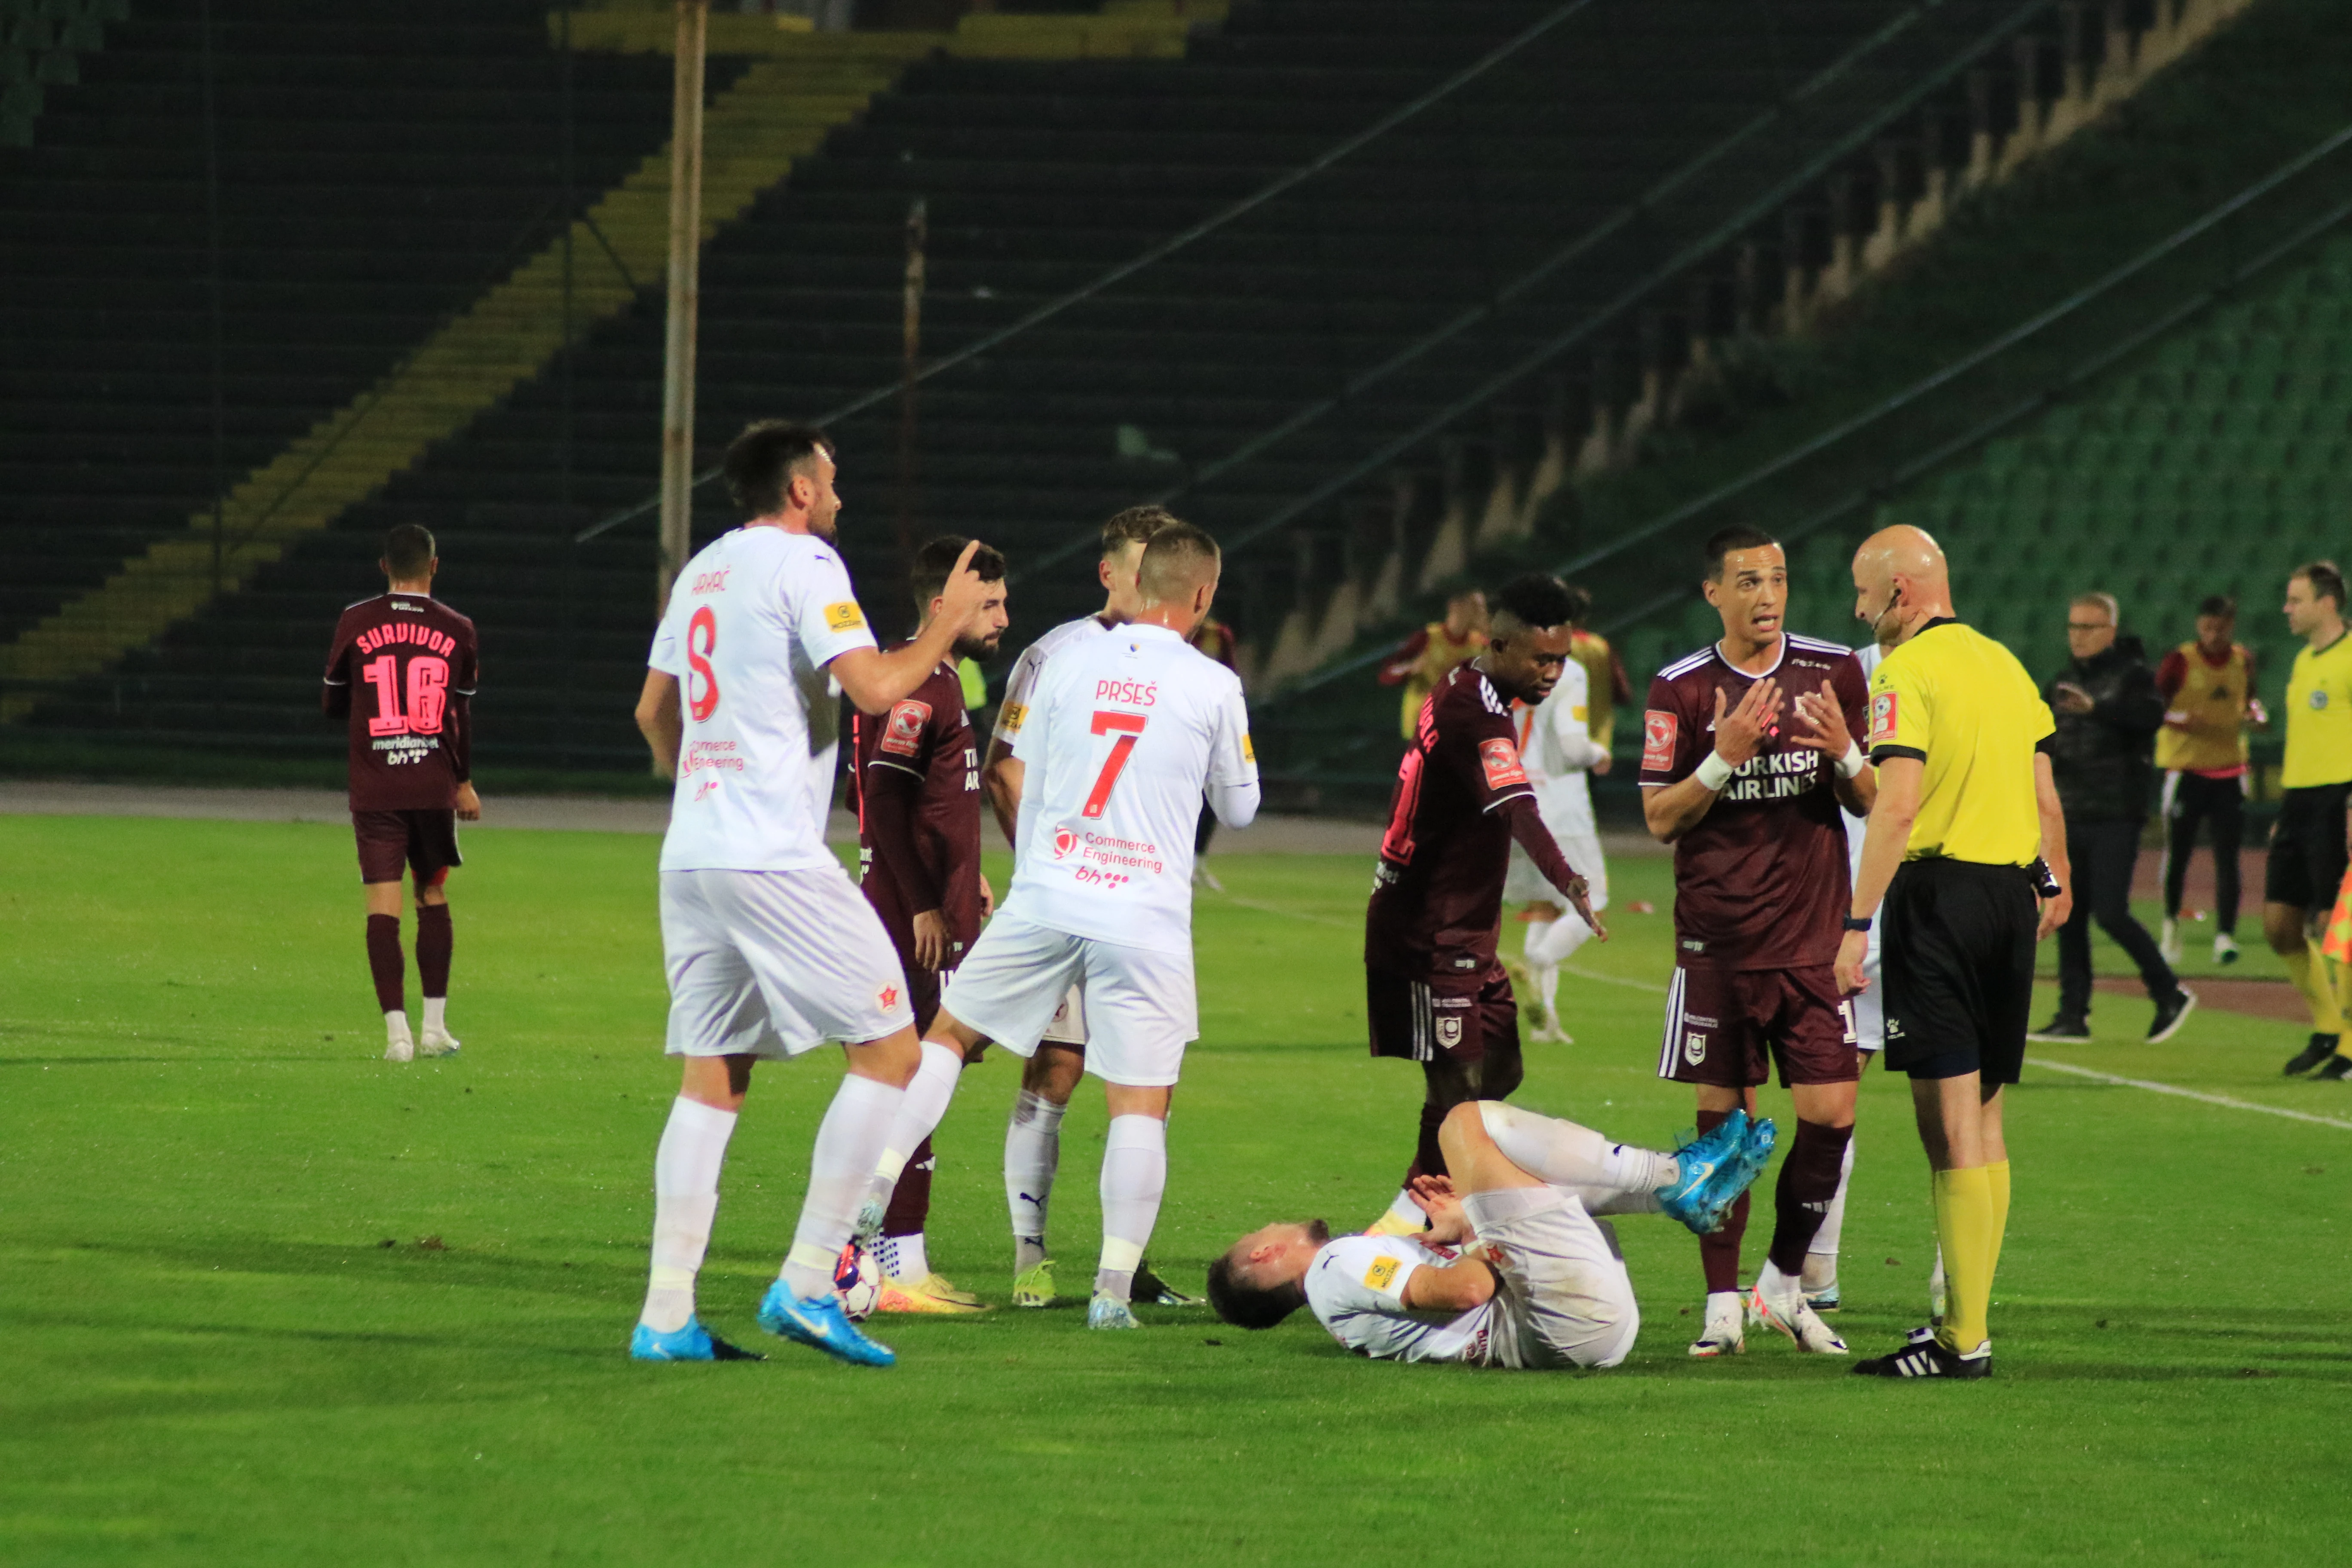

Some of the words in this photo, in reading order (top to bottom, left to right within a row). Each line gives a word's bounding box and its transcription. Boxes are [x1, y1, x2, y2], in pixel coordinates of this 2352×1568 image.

[688, 604, 720, 723] 8
[363, 655, 449, 736] 16
[1096, 677, 1158, 706] PRŠEŠ
[1082, 710, 1148, 820] 7
[1734, 750, 1819, 777] URKISH
[1086, 832, 1155, 854] Commerce
[1083, 847, 1162, 874] Engineering
